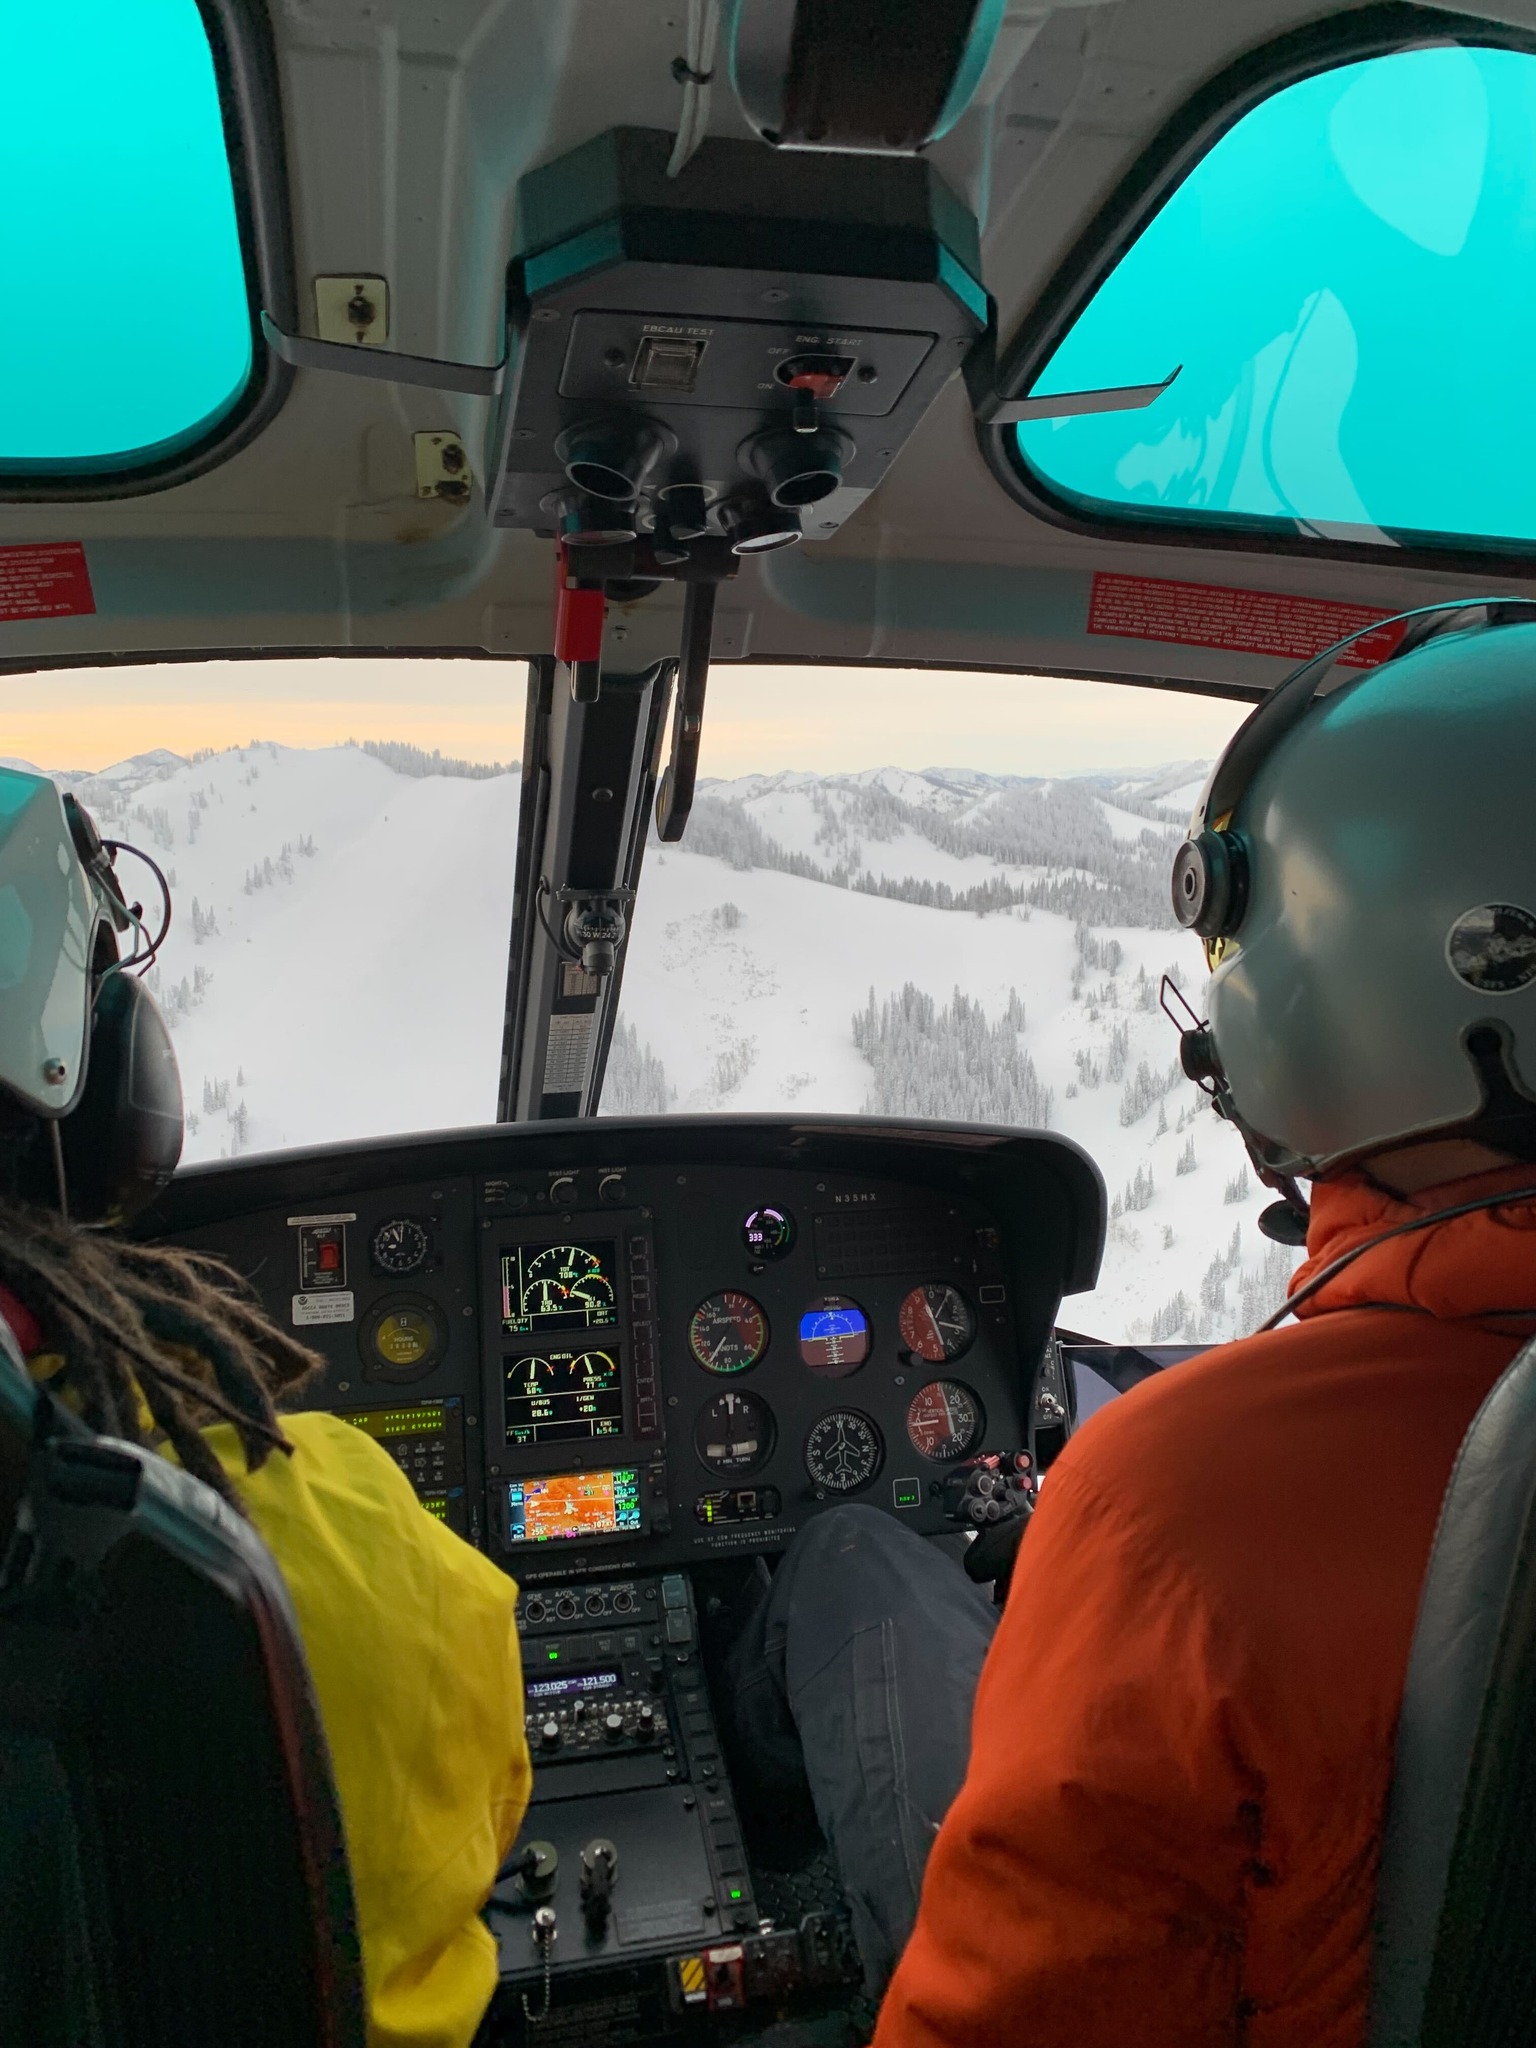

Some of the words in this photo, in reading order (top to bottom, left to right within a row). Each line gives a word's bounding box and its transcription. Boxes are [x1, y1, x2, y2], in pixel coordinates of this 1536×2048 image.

[642, 324, 683, 335] EBCAU
[686, 326, 715, 336] TEST
[826, 337, 864, 346] START
[767, 347, 790, 355] OFF
[757, 382, 774, 390] ON
[749, 1233, 763, 1242] 333
[929, 1290, 935, 1299] 0
[953, 1306, 958, 1314] 2
[918, 1340, 924, 1349] 6
[933, 1344, 939, 1353] 5
[925, 1397, 933, 1406] 10
[950, 1394, 961, 1405] 20
[712, 1409, 718, 1417] L
[743, 1405, 749, 1414] R
[958, 1414, 969, 1423] 30
[952, 1433, 963, 1442] 20
[862, 1445, 870, 1453] N
[618, 1502, 635, 1510] 1200
[588, 1564, 621, 1573] CONDITIONS
[622, 1562, 637, 1570] ONLY
[582, 1674, 617, 1686] 121.500
[533, 1681, 568, 1693] 123.025
